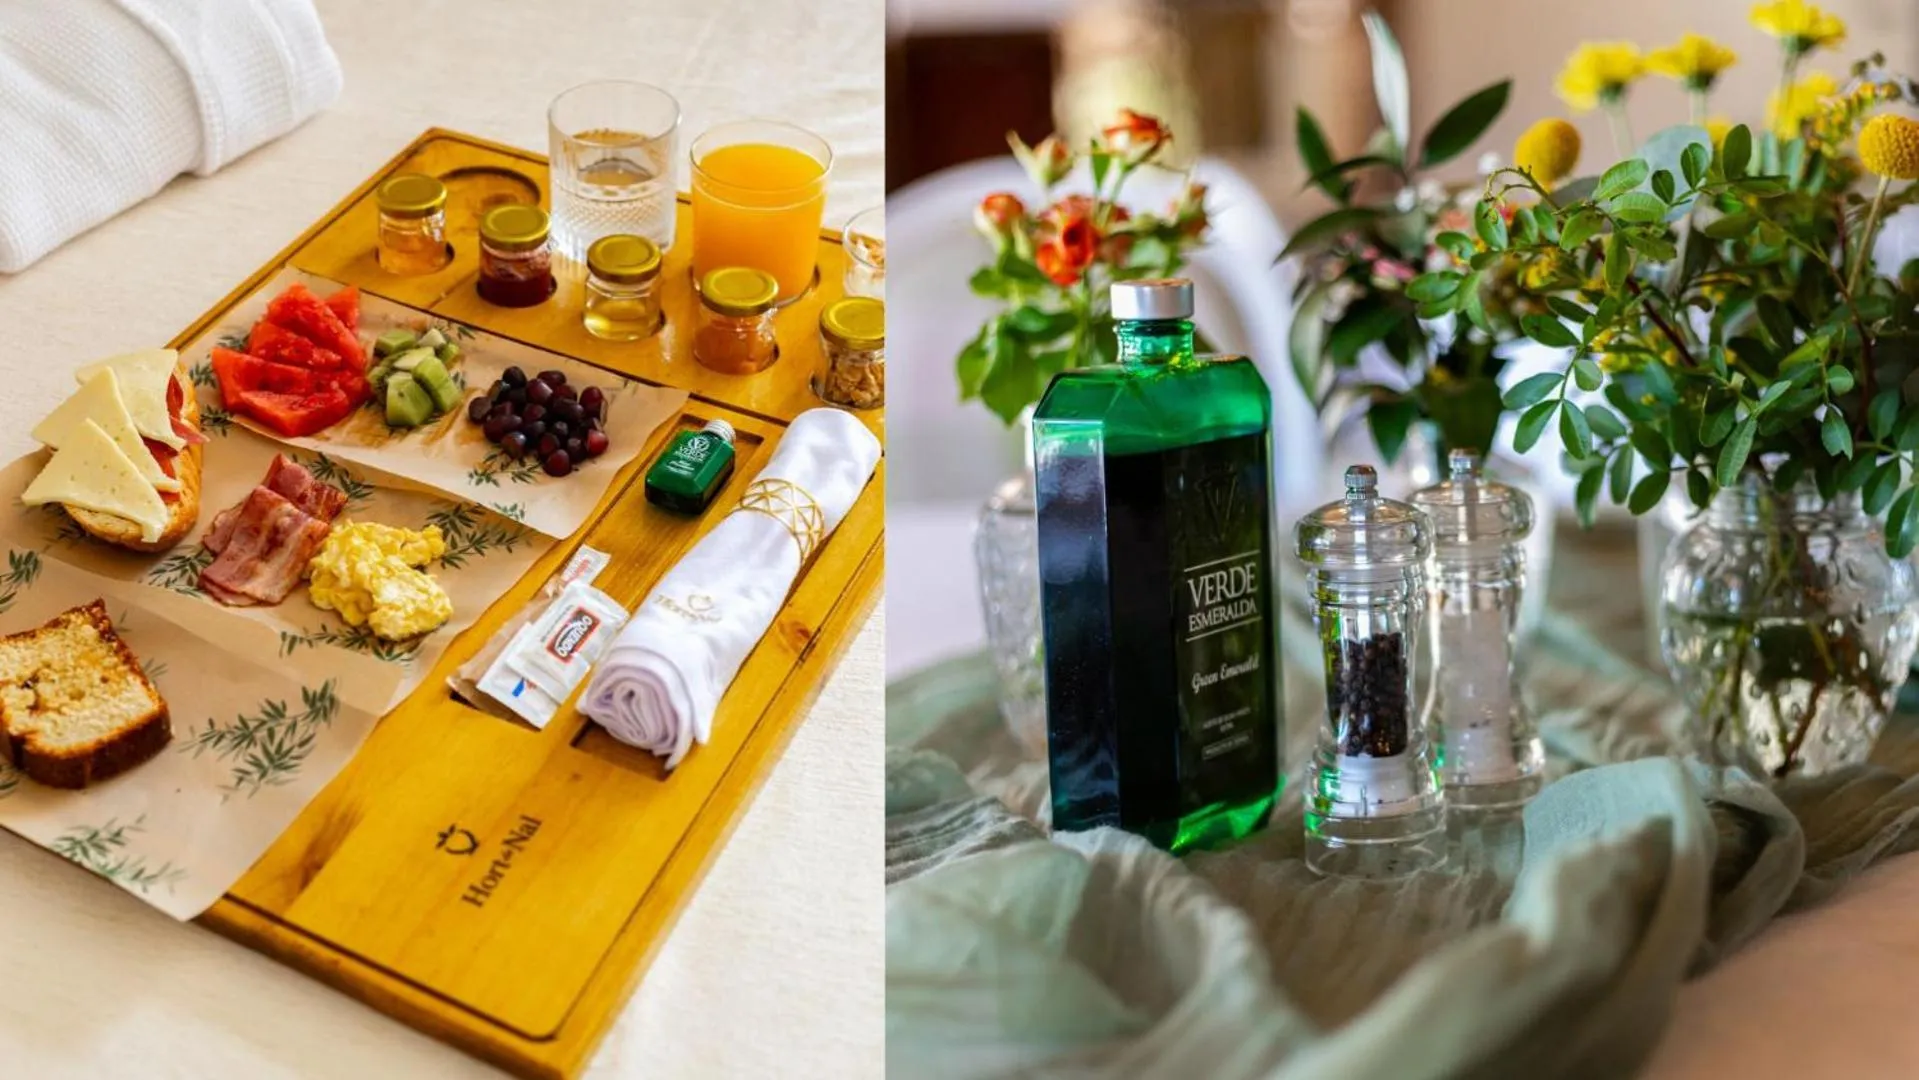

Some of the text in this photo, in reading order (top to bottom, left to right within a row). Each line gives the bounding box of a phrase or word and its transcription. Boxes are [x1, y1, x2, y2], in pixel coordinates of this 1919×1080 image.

[1188, 562, 1258, 608] VERDE
[1188, 597, 1258, 632] ESMERALDA
[461, 858, 511, 908] Hort
[501, 814, 542, 852] Nal
